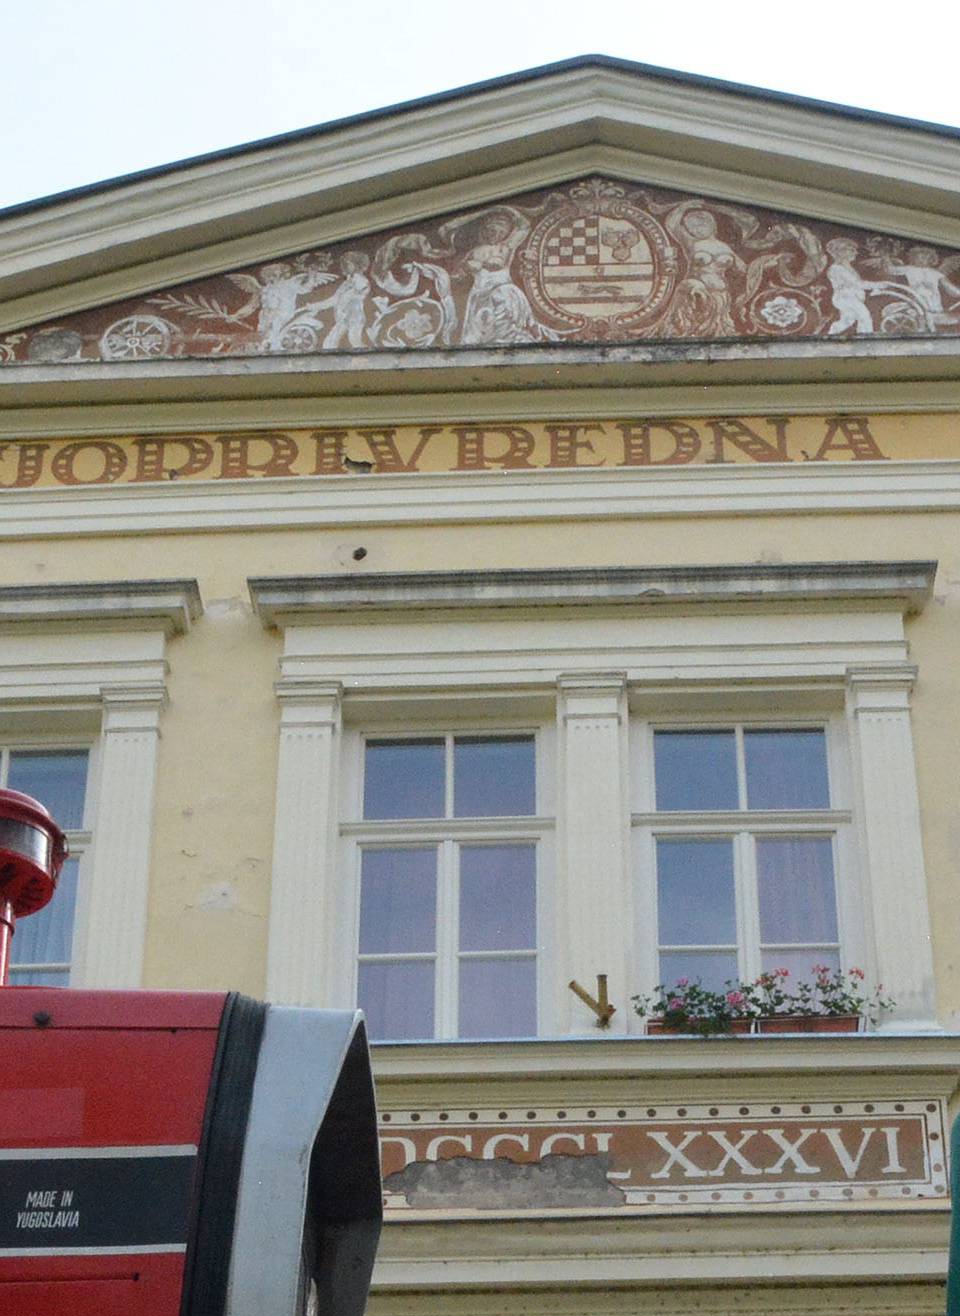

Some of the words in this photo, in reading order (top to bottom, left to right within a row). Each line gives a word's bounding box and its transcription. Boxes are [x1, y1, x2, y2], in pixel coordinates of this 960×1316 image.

[25, 1190, 58, 1208] MADE
[61, 1190, 74, 1207] IN
[16, 1211, 80, 1228] YUGOSLAVIA
